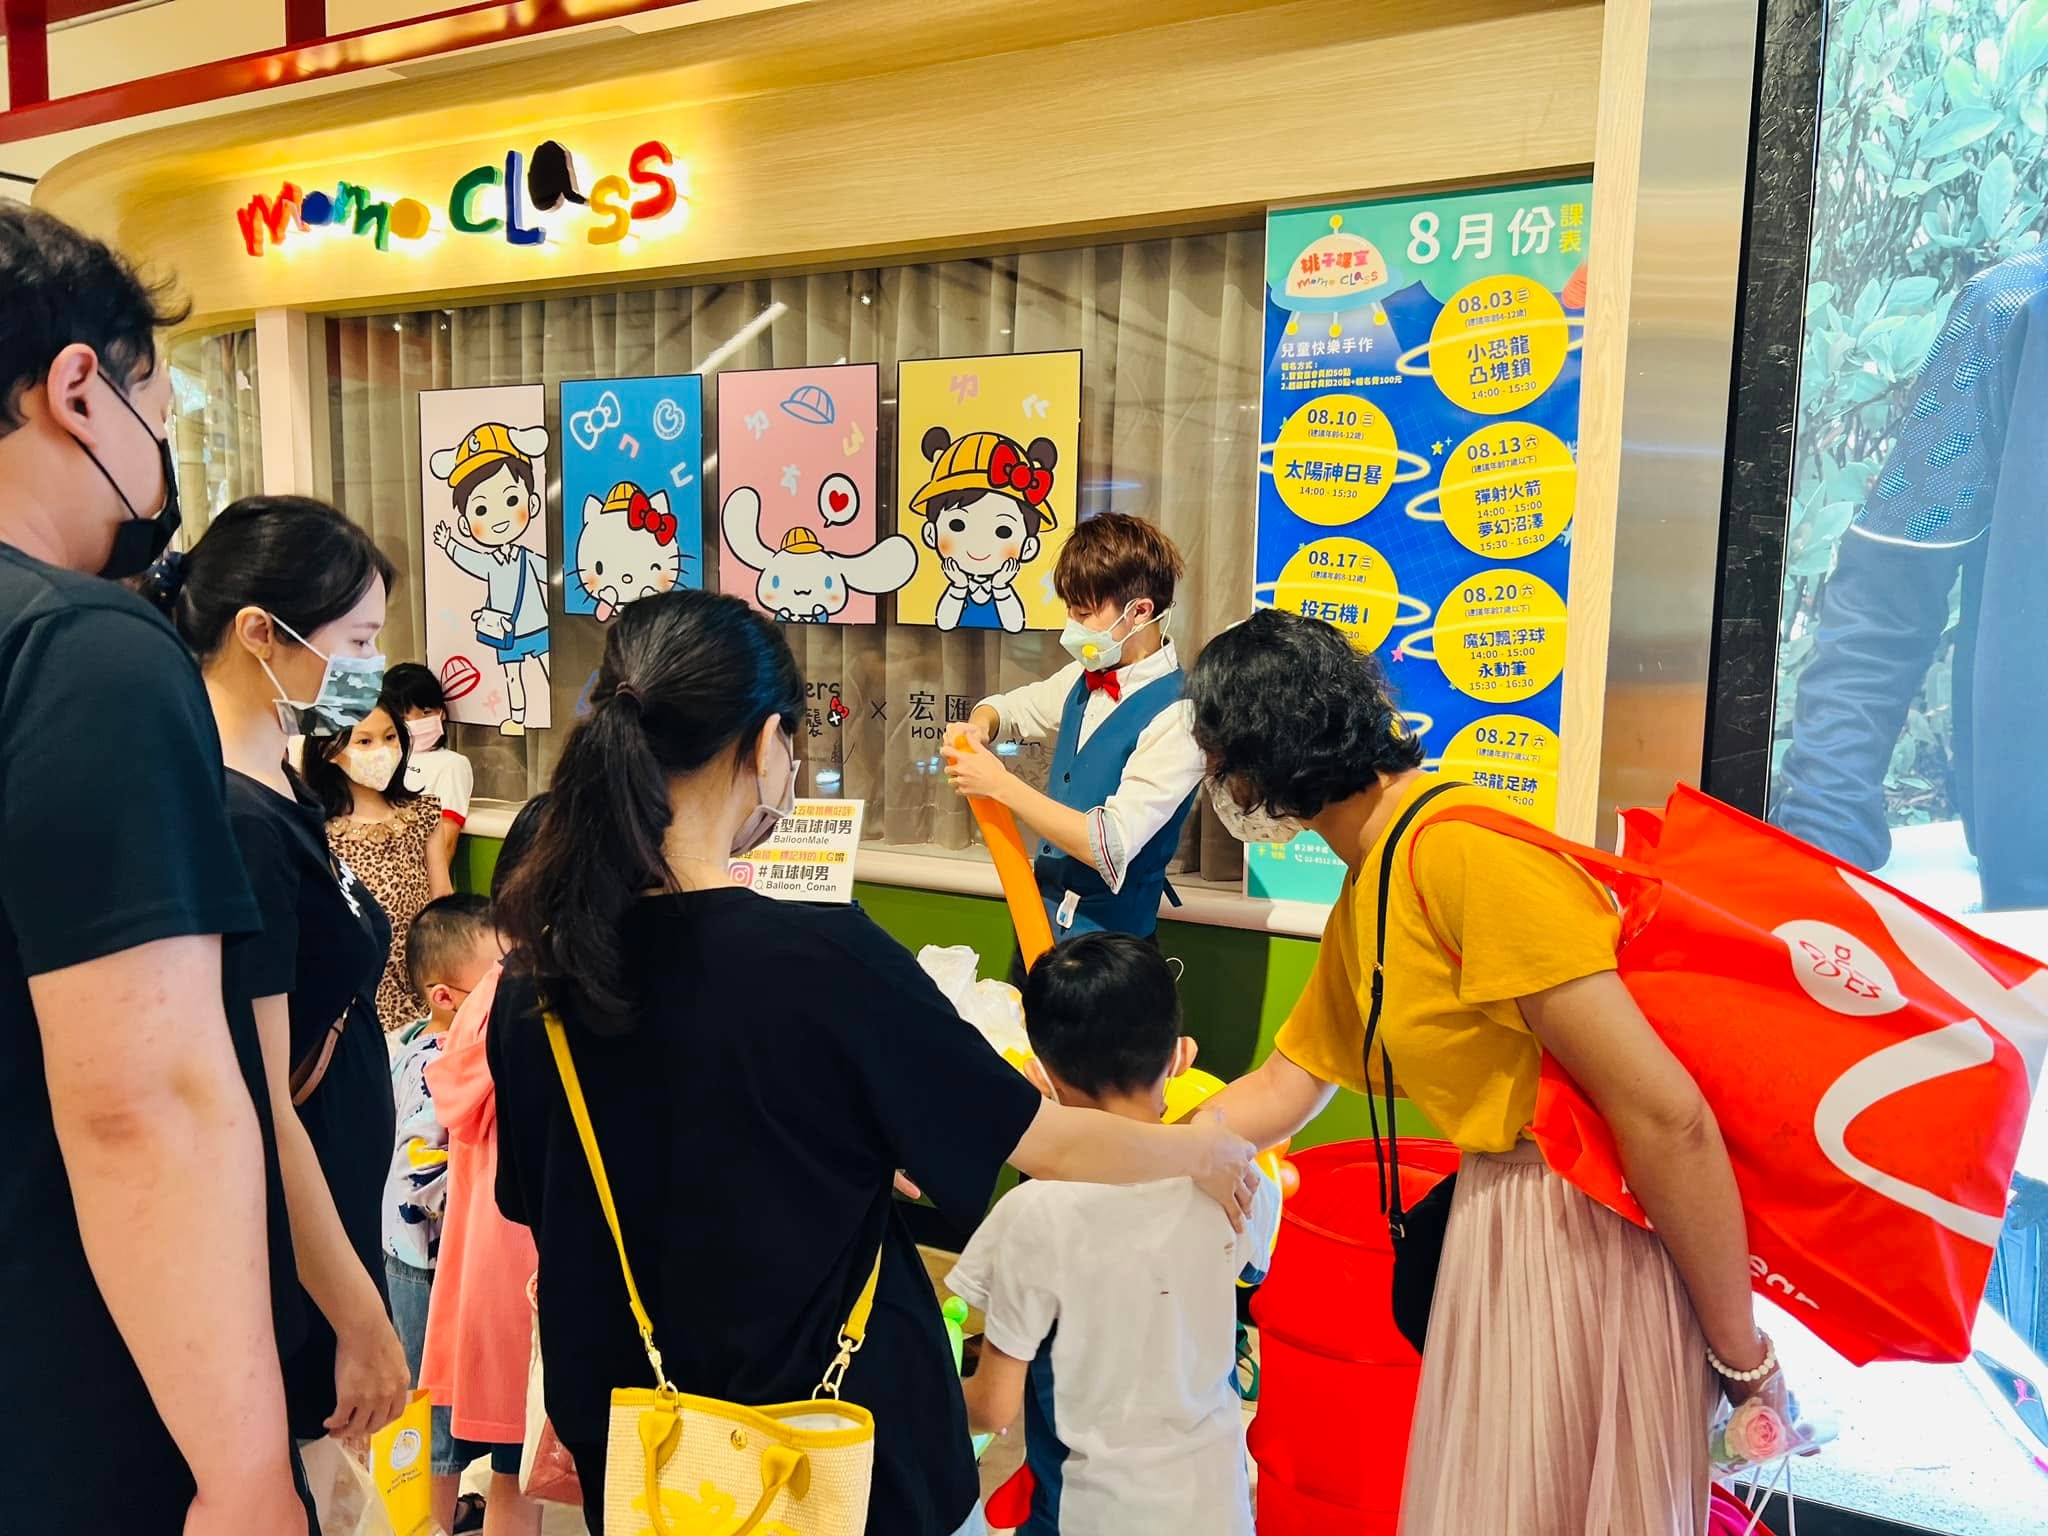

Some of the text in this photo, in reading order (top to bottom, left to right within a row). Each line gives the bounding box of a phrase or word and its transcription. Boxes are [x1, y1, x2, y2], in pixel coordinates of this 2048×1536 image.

[1406, 206, 1555, 265] 8月份
[1559, 203, 1584, 254] 課表
[1458, 290, 1513, 313] 08.03
[1281, 337, 1374, 358] 兒童快樂手作
[1468, 335, 1530, 363] 小恐龍
[1470, 357, 1531, 385] 凸塊鎖
[1472, 388, 1499, 400] 14:00
[1509, 381, 1537, 393] 15:30
[1307, 409, 1357, 426] 08.10
[1467, 437, 1521, 460] 08.13
[1285, 460, 1382, 485] 太陽神日晷
[1300, 487, 1325, 496] 14:00
[1333, 489, 1358, 498] 15:30
[1475, 480, 1541, 506] 彈射火箭
[1478, 507, 1505, 519] 14:00
[1515, 500, 1543, 513] 15:00
[1478, 513, 1545, 538] 夢幻沼澤
[1480, 540, 1508, 551] 15:30
[1518, 534, 1545, 546] 16:30
[1309, 551, 1357, 568] 08.17
[1463, 585, 1517, 603] 08.20
[1463, 627, 1545, 648] 魔幻飄浮球
[1471, 650, 1498, 659] 14:00
[1507, 648, 1535, 657] 15:00
[1479, 661, 1527, 678] 永動筆
[1470, 681, 1497, 690] 15:30
[1507, 679, 1534, 688] 16:30
[1475, 727, 1529, 747] 08.27
[1473, 771, 1538, 794] 恐龍足跡
